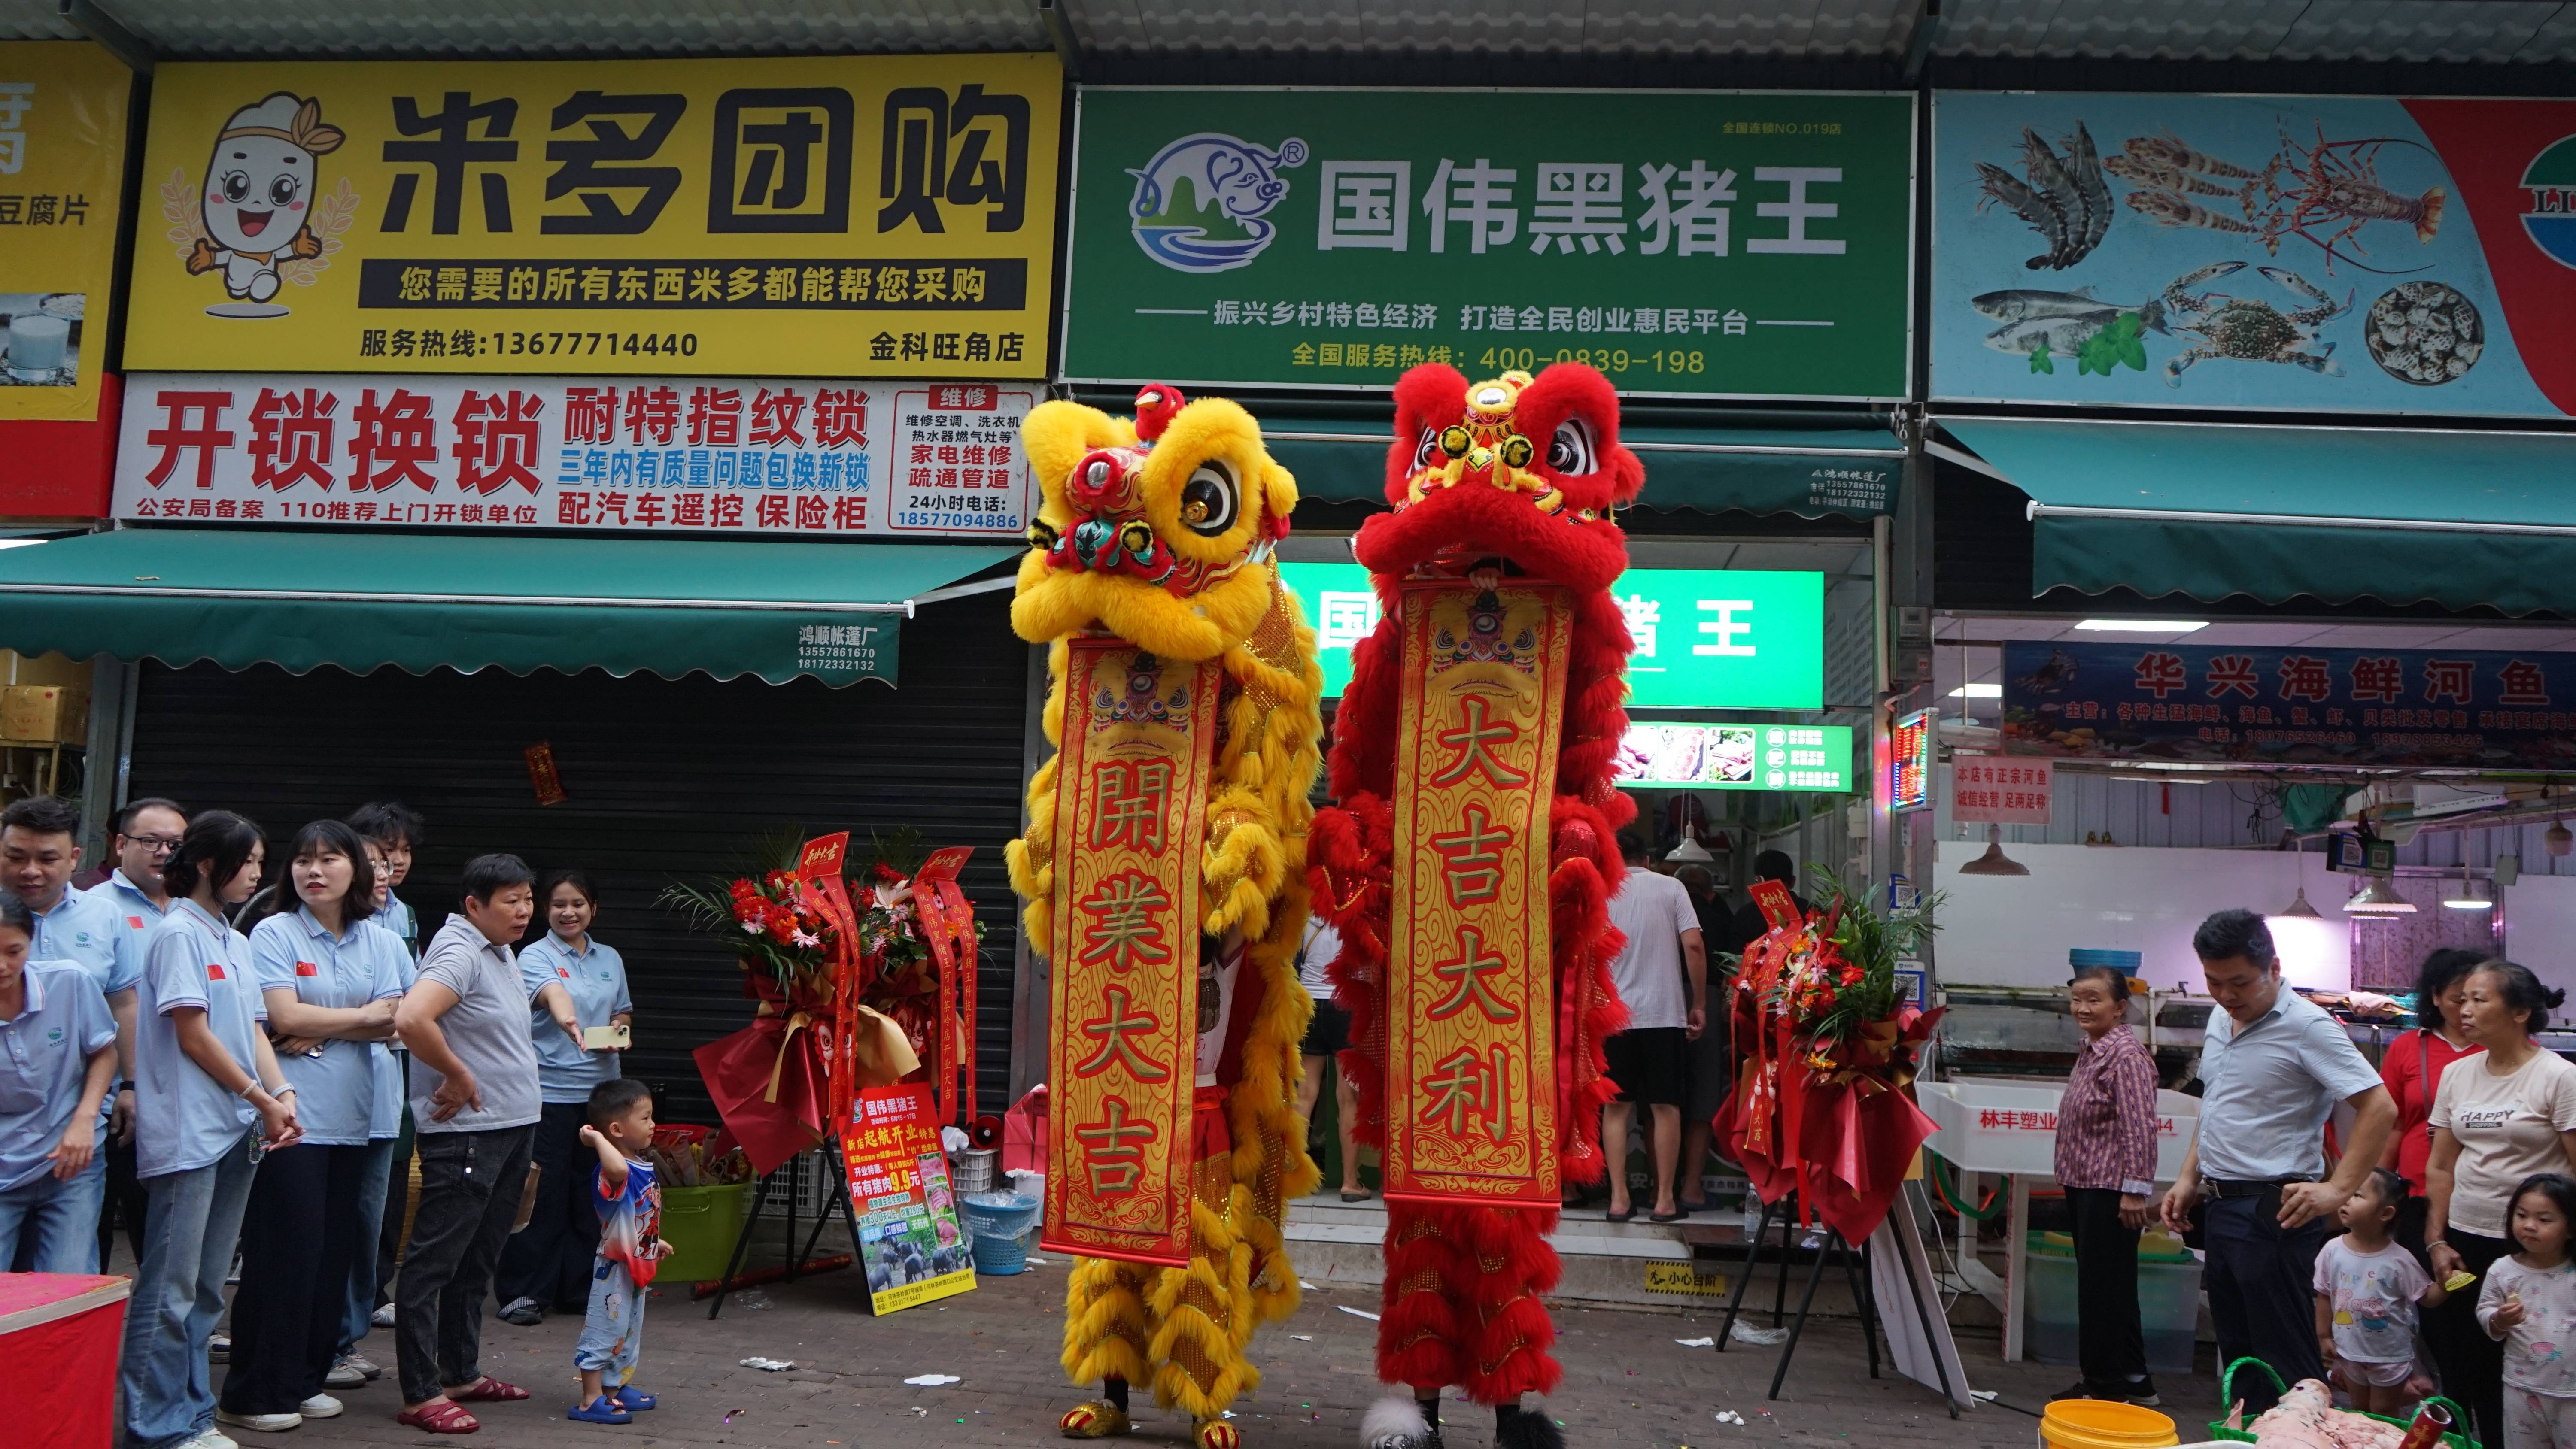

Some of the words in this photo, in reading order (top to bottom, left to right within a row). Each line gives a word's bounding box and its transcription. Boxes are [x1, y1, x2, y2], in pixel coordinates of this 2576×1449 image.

[1723, 121, 1841, 135] 全国连锁NO.019店
[380, 84, 1030, 235] 米多团购
[1317, 158, 1846, 257] 国伟黑猪王
[2534, 190, 2576, 212] LI
[398, 267, 987, 302] 您需要的所有东西米多都能帮您采购
[1213, 300, 1438, 330] 振兴乡村特色经济
[1460, 305, 1748, 335] 打造全民创业惠民平台
[360, 328, 697, 358] 服务热线:13677714440
[869, 331, 1024, 362] 金科旺角店
[940, 388, 987, 407] 维修
[563, 386, 870, 449] 耐特指纹锁
[905, 415, 1020, 428] 维修空调、洗衣机
[145, 388, 544, 497] 开锁换锁
[912, 430, 1012, 443] 热水器燃气灶等
[911, 445, 1012, 466] 家电维修
[558, 448, 870, 491] 三年内有质量问题包换新锁
[909, 468, 1010, 489] 疏通管道
[1810, 482, 1825, 492] 电话
[1827, 480, 1886, 491] 13557861670
[1827, 489, 1886, 499] 18172332132
[136, 498, 264, 518] 公安局备案
[280, 501, 538, 524] 110推荐上门开锁单位
[558, 491, 744, 528] 配汽车遥控
[756, 494, 867, 531] 保险柜
[909, 495, 1005, 512] 24小时电话:
[898, 512, 1017, 527] 18577094886
[799, 625, 877, 646] 鸿顺帐蓬厂
[799, 647, 875, 658] 13557861670
[798, 659, 874, 670] 18172332132
[2133, 652, 2550, 706] 华兴海鲜河鱼
[1958, 766, 2047, 785] 本店有正宗河鱼
[1958, 790, 1999, 808] 诚信经营
[2005, 792, 2046, 809] 足两足称
[1426, 700, 1524, 1141] 大吉大利
[1078, 762, 1173, 1197] 開業大吉
[866, 1096, 918, 1116] 国伟黑猪王
[2461, 1110, 2515, 1121] HAPPY
[1980, 1109, 2057, 1130] 林丰塑业
[852, 1170, 920, 1197] 所有猪肉9.9元
[1669, 1271, 1716, 1288] 小心台阶
